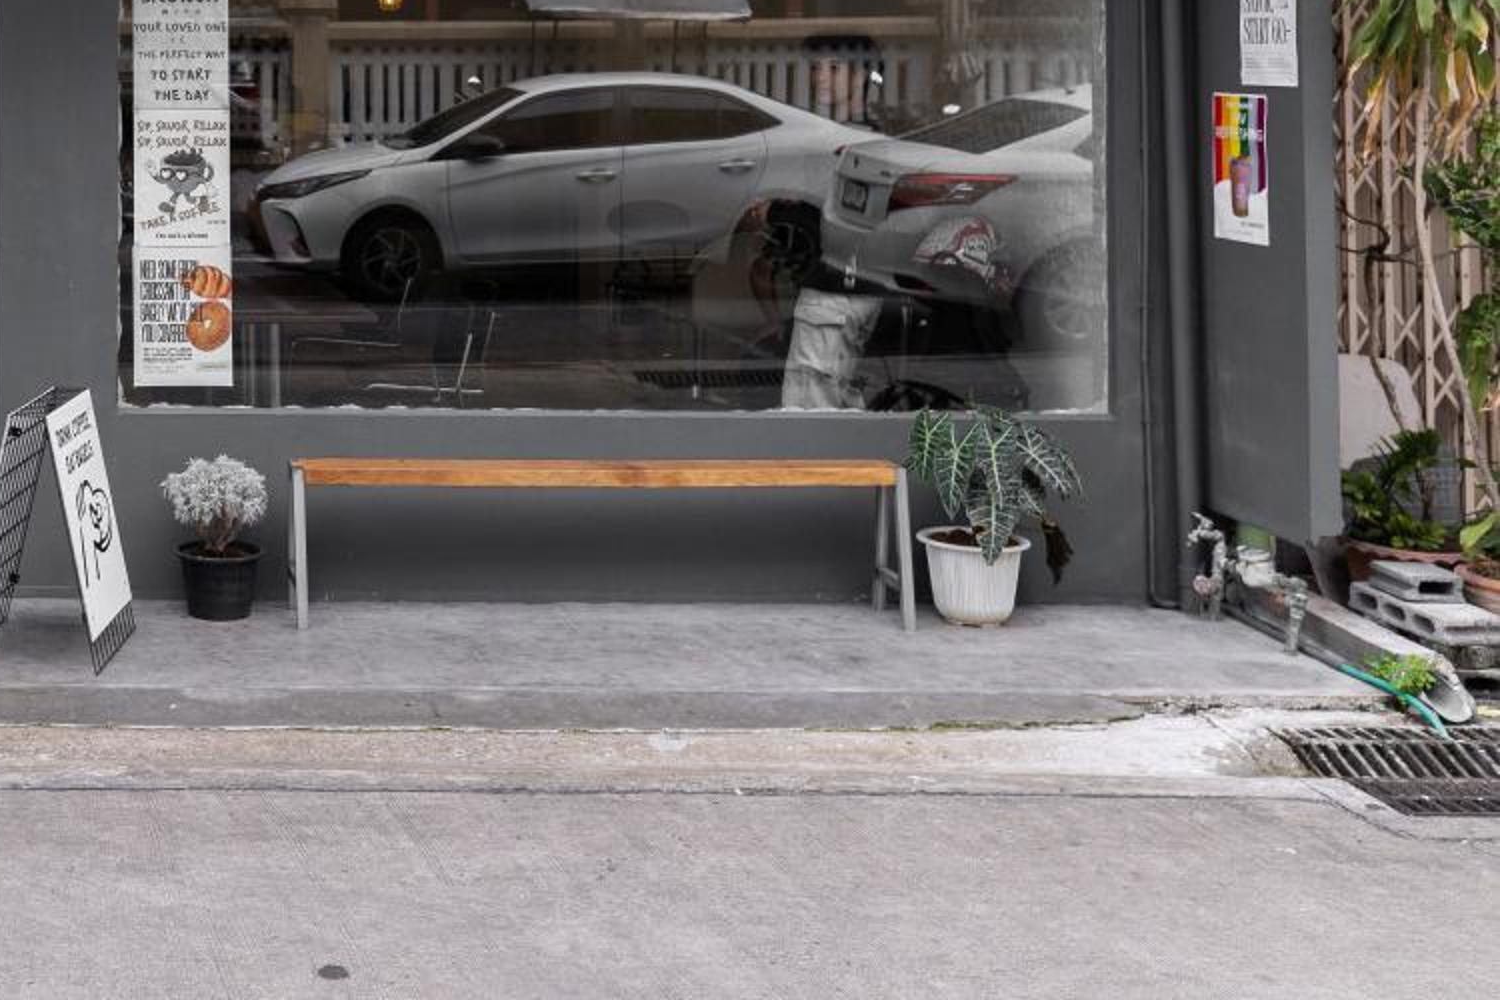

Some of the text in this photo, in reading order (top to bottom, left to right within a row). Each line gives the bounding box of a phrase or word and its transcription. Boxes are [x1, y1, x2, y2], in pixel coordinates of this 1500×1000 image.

[134, 21, 161, 32] YOUR
[151, 67, 212, 81] TO START
[154, 89, 181, 101] THE
